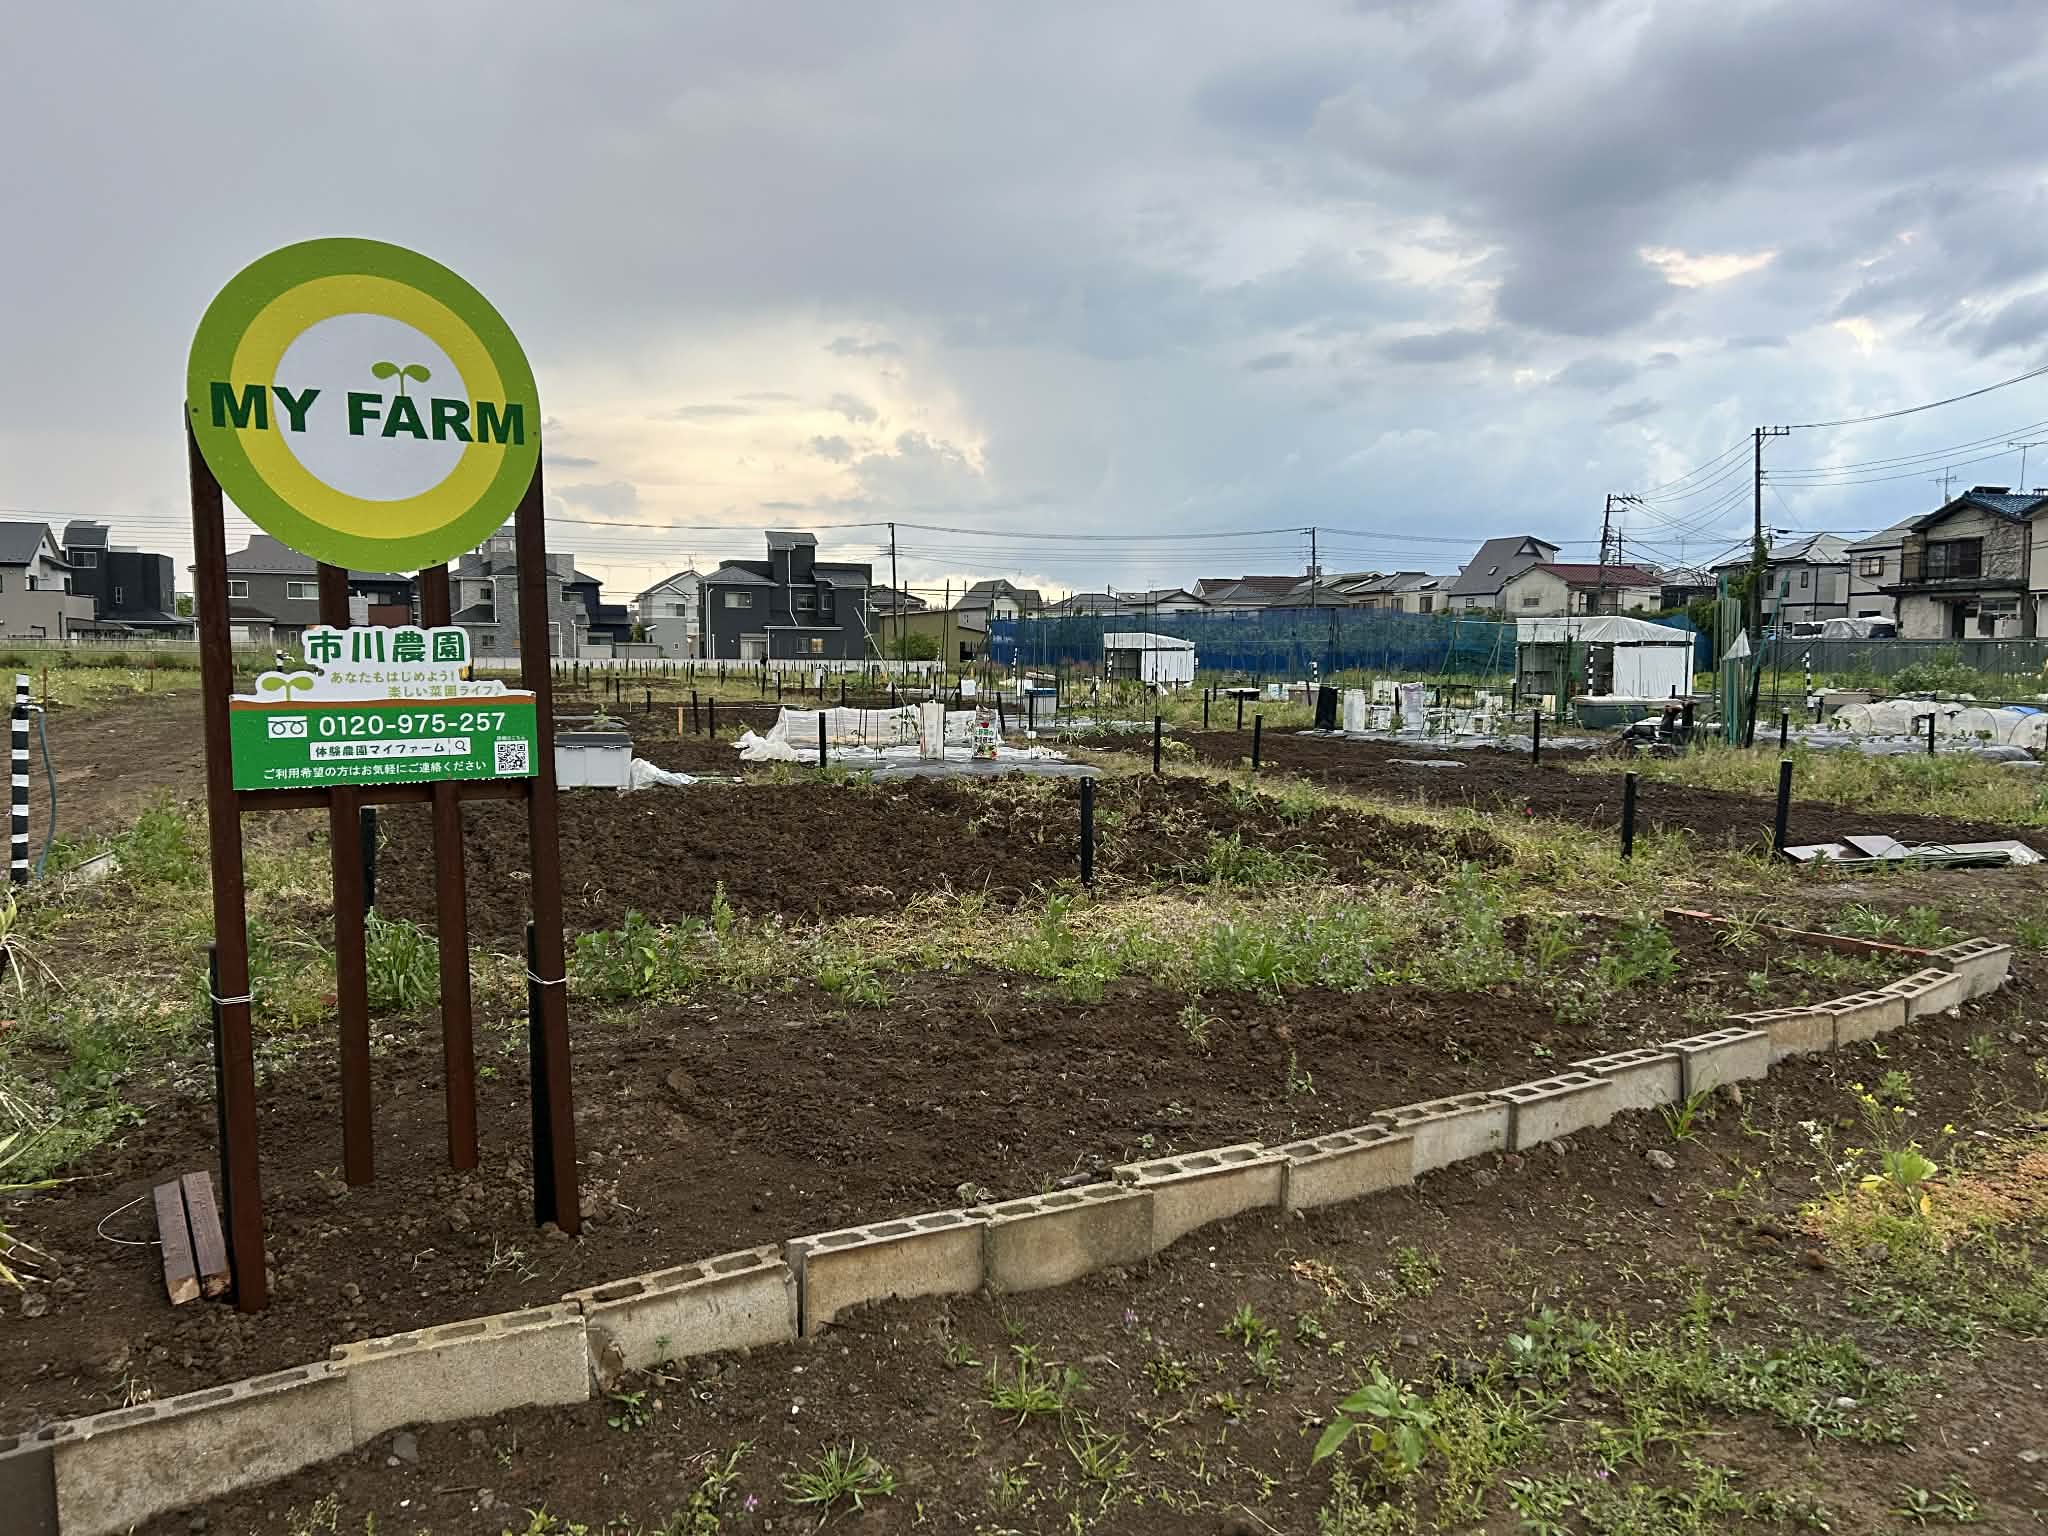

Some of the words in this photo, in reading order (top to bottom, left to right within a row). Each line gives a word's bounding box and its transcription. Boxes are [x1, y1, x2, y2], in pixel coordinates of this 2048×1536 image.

[210, 382, 321, 433] MY
[347, 391, 525, 446] FARM
[307, 630, 466, 664] 市川農園
[319, 712, 506, 737] 0120-975-257
[315, 743, 445, 758] 体験農園マイファーム
[263, 761, 486, 780] ご利用希望の方はお気軽にご連絡ください
